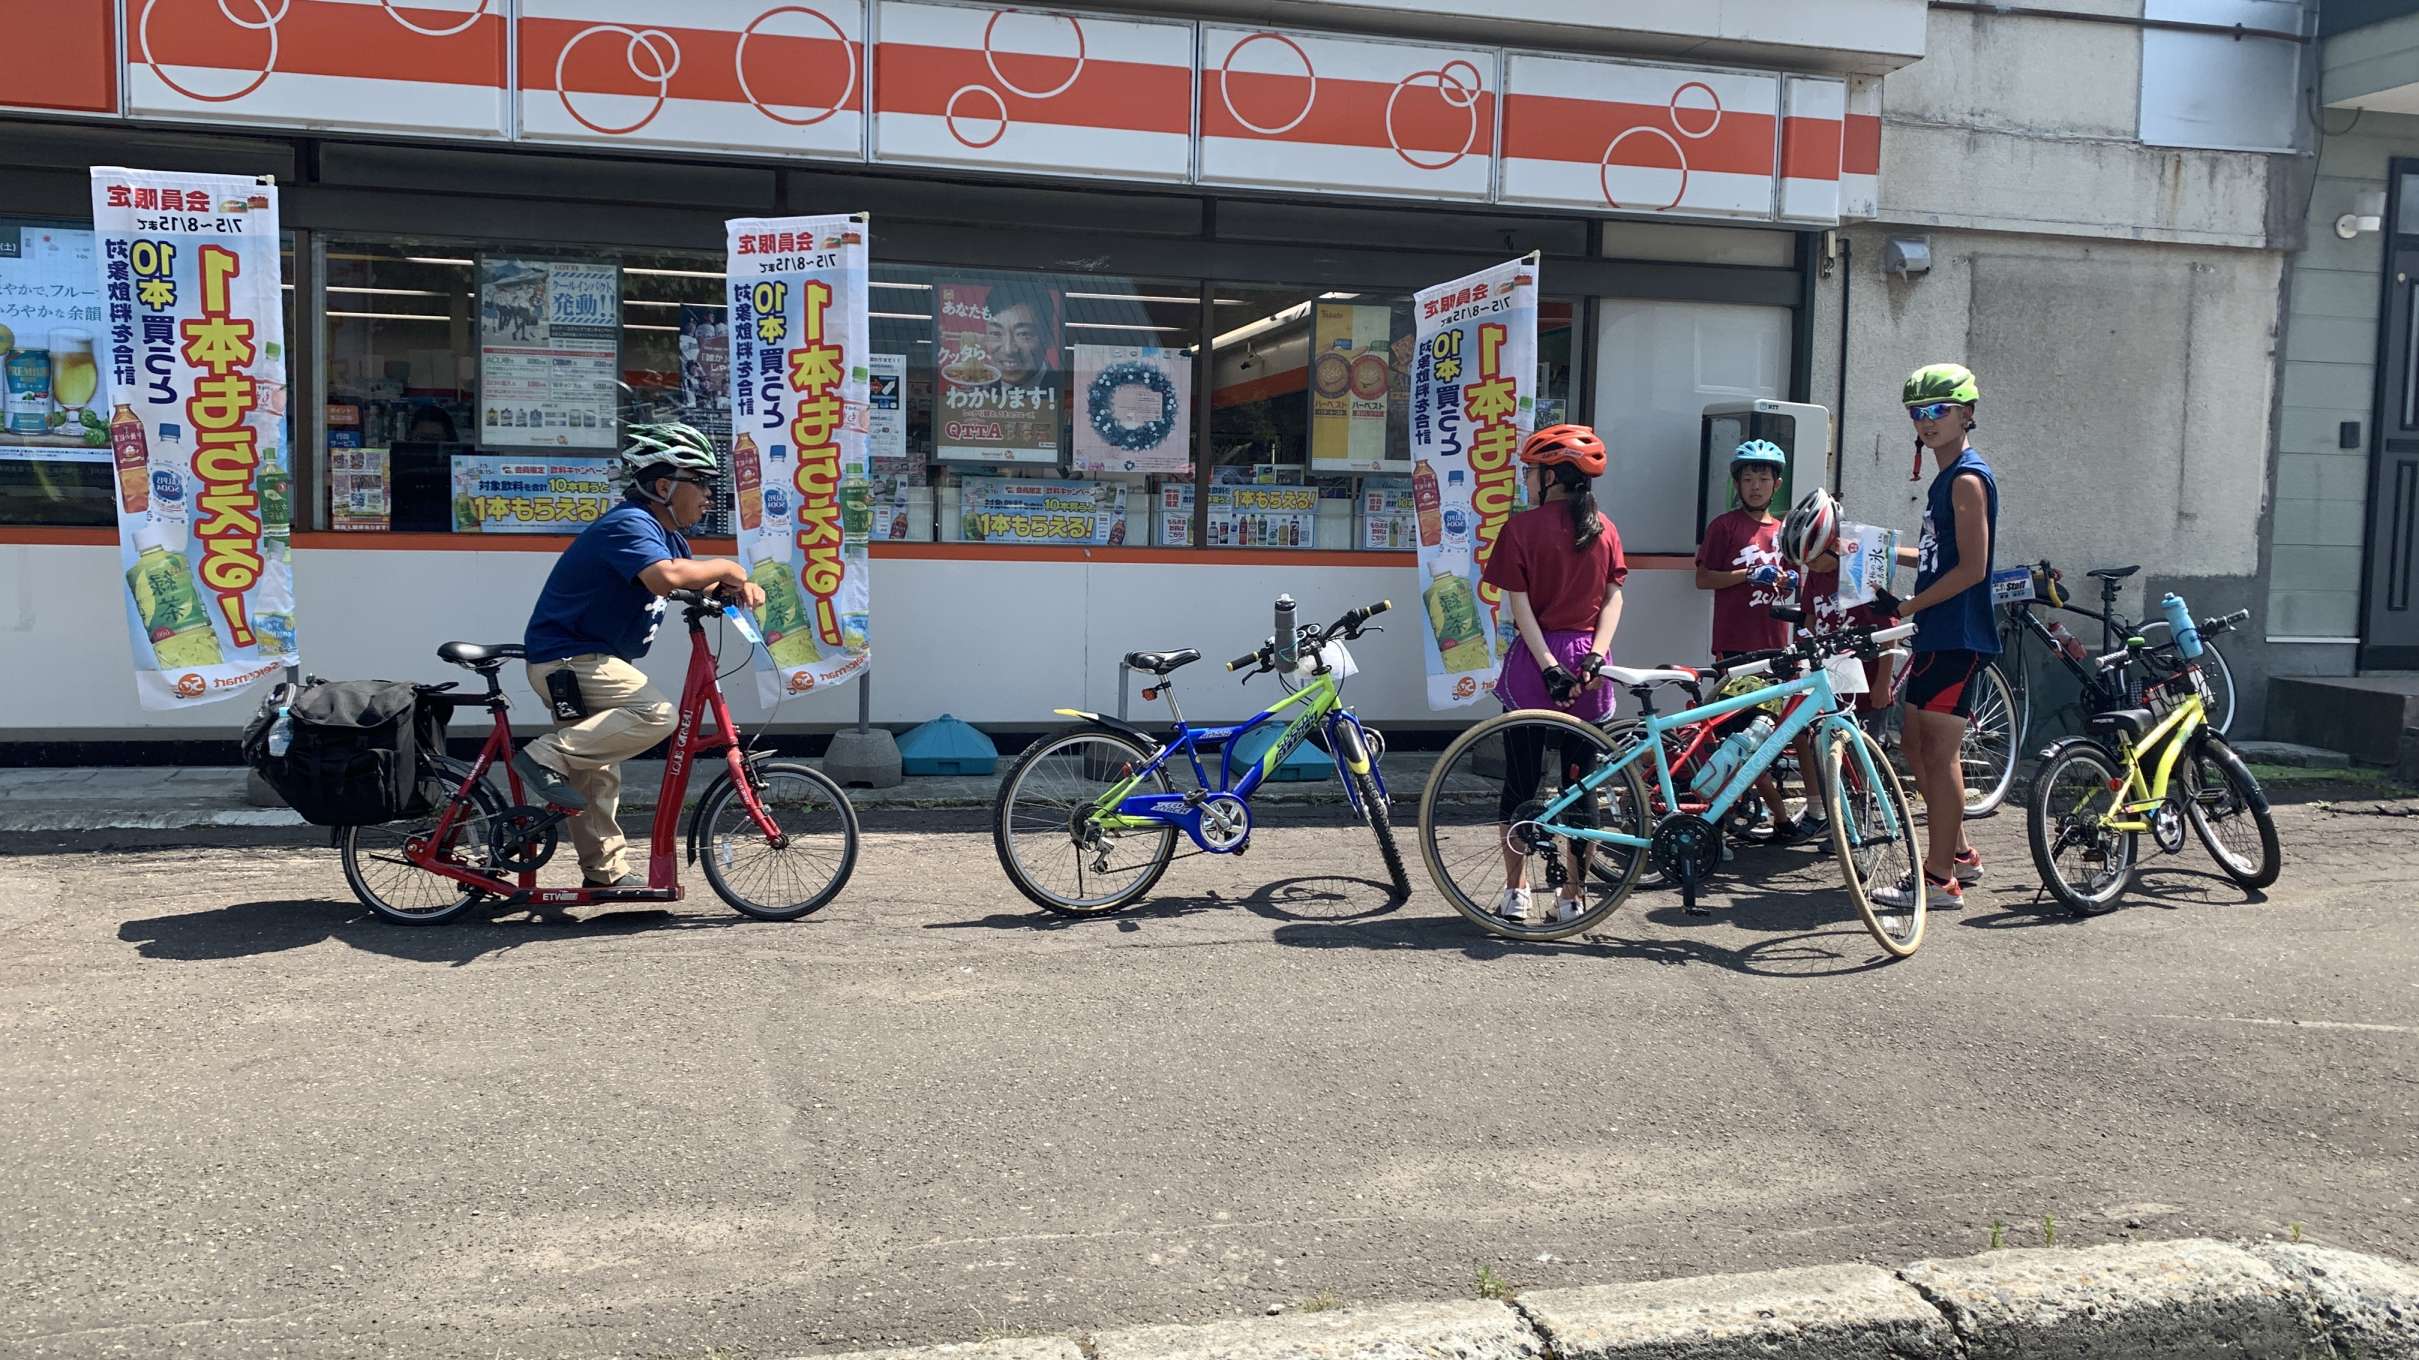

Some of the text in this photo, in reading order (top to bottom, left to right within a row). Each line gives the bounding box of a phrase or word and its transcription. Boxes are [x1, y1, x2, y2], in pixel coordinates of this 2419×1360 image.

[945, 385, 1055, 410] わかります!
[945, 421, 1003, 441] QTTA
[981, 513, 1095, 539] 1本もらえる!
